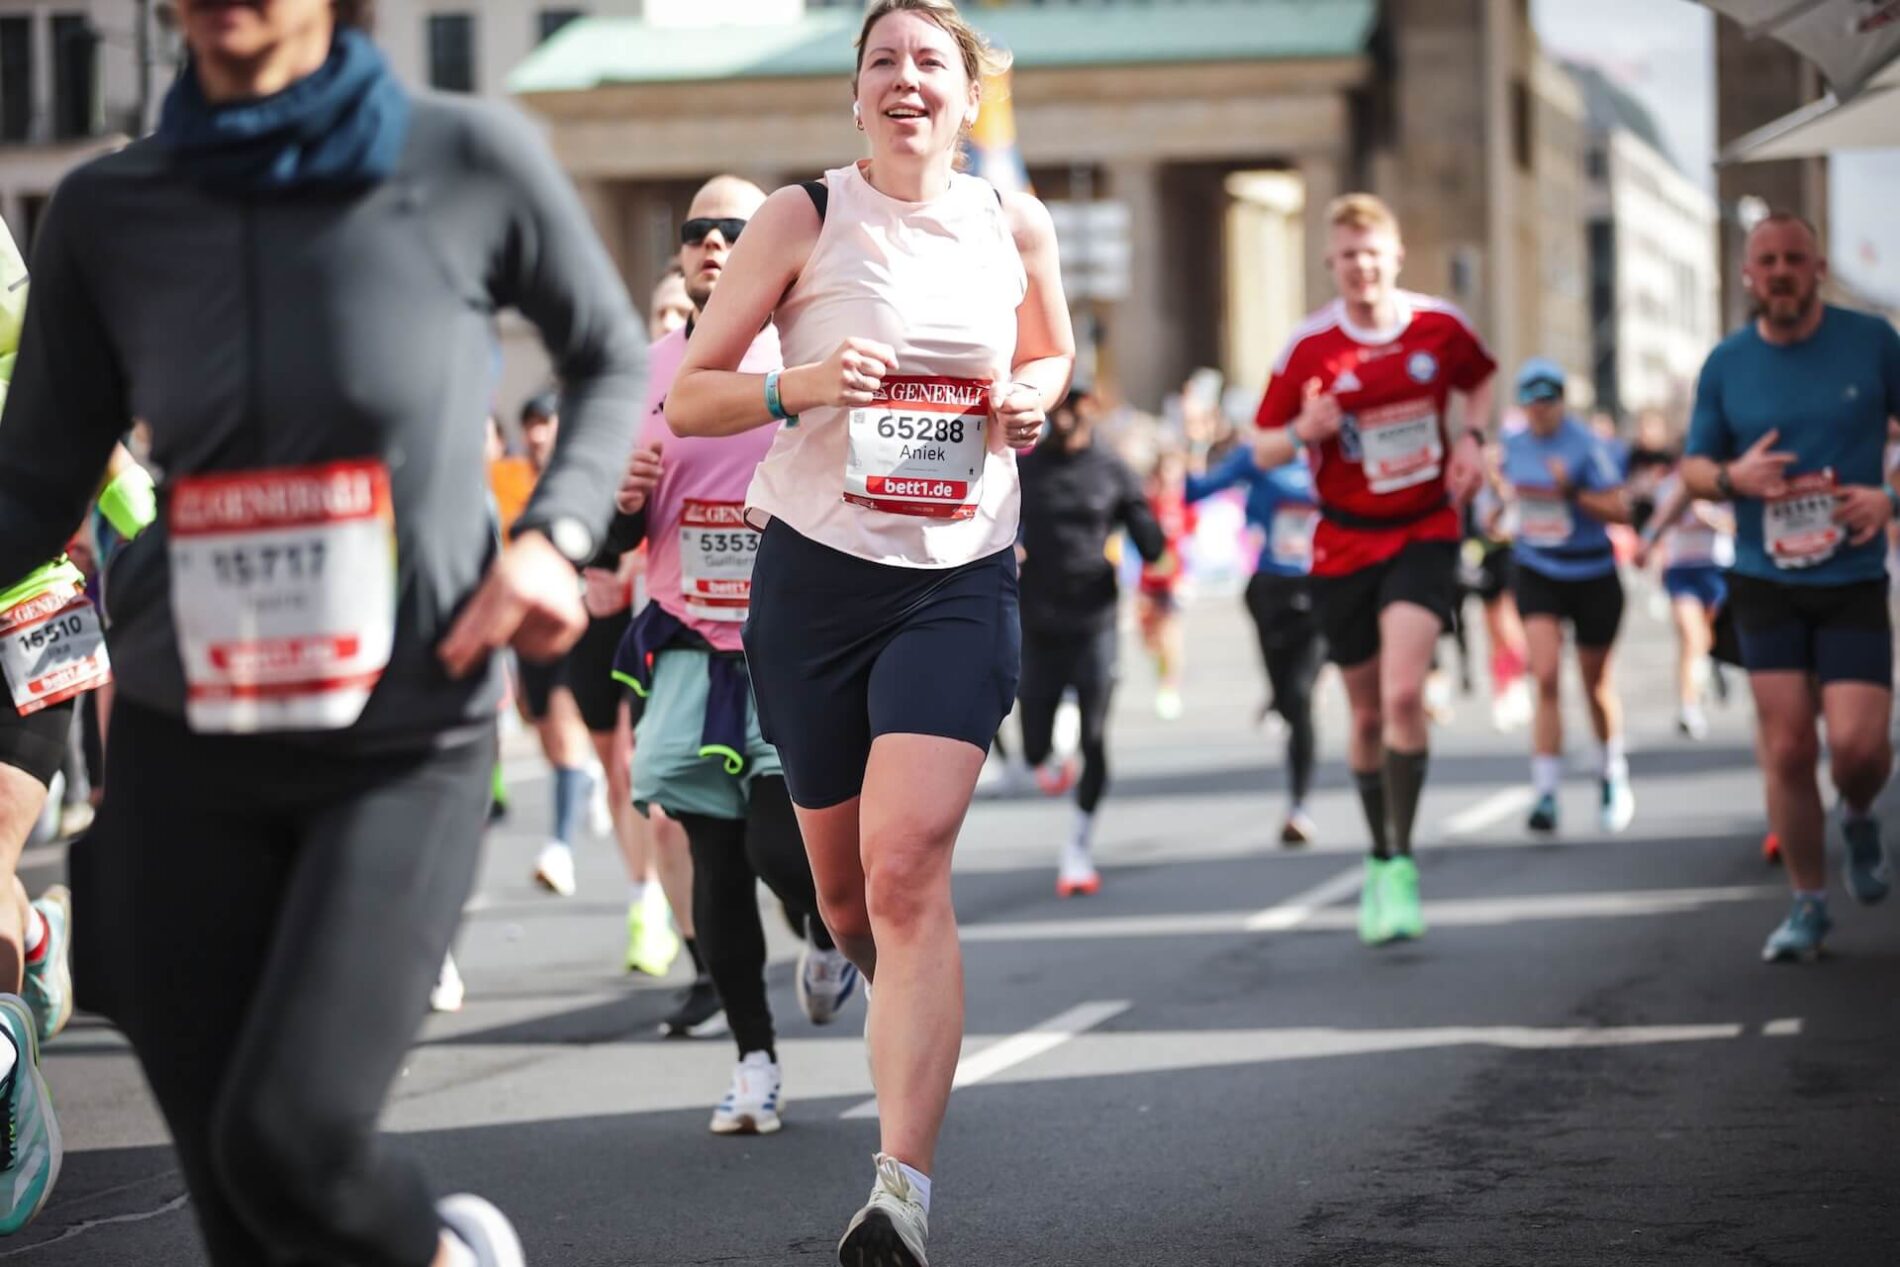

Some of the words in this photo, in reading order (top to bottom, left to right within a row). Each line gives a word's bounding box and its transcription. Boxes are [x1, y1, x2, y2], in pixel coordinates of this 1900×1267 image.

[890, 382, 983, 406] GENERALI
[877, 415, 965, 443] 65288
[900, 445, 946, 461] Aniek
[884, 479, 954, 497] bett1.de
